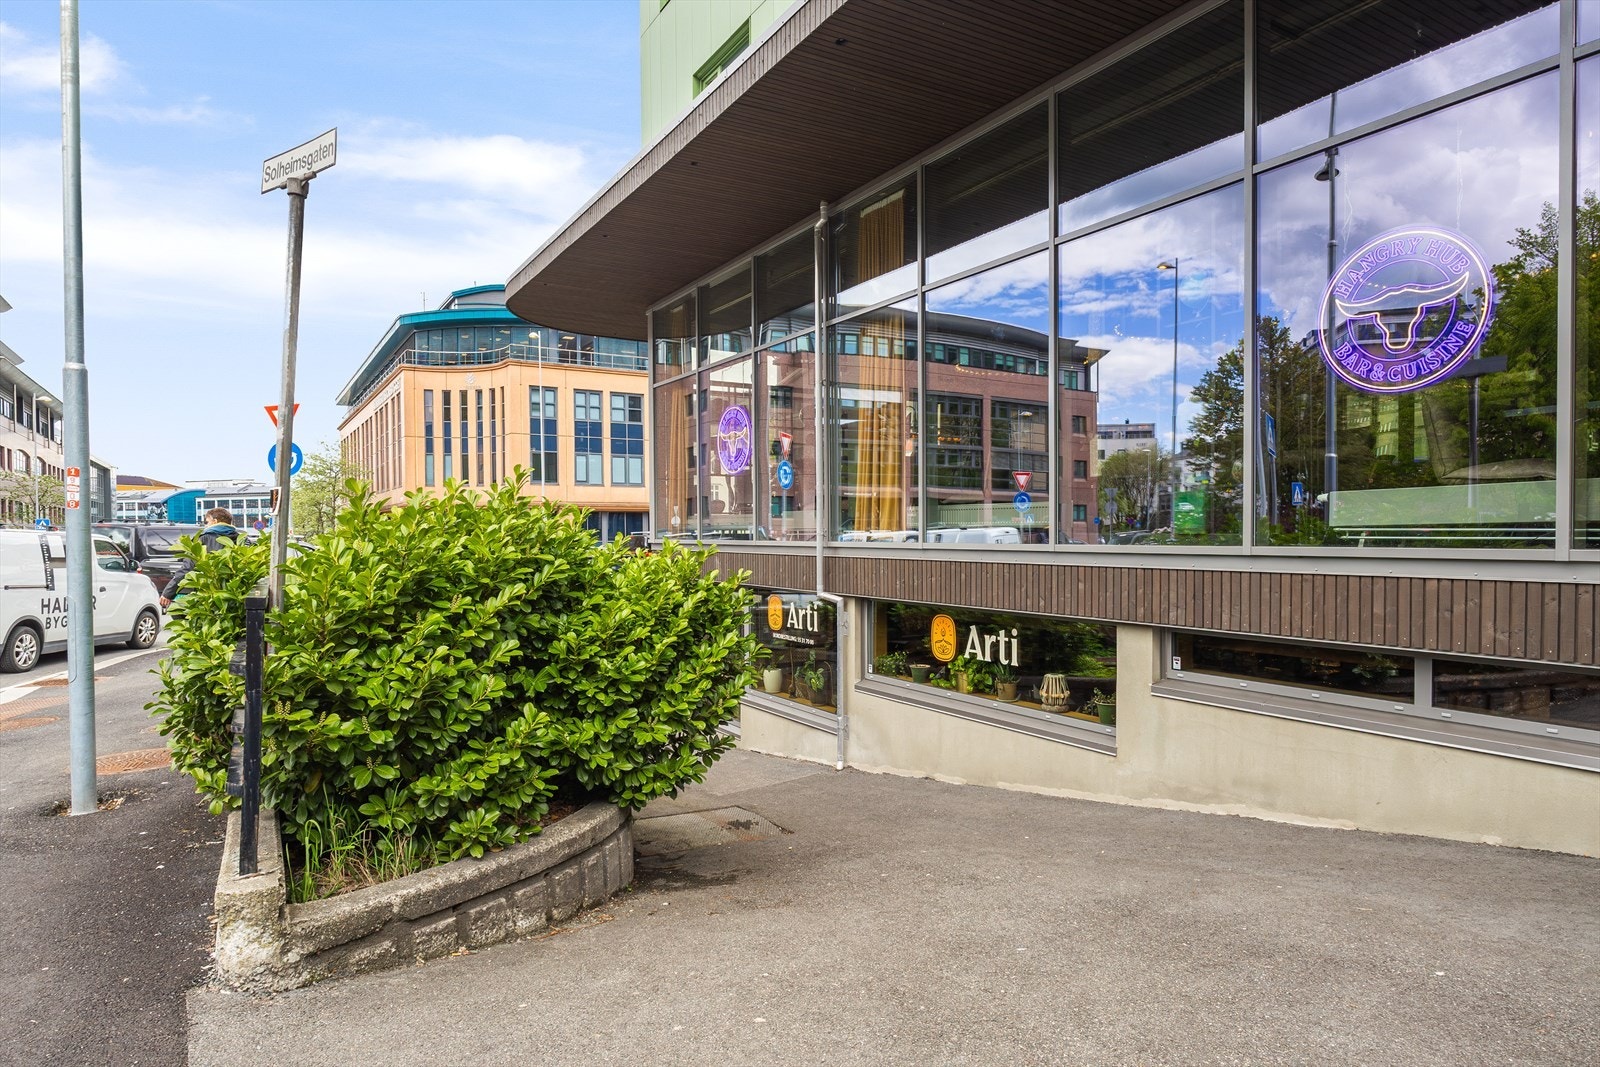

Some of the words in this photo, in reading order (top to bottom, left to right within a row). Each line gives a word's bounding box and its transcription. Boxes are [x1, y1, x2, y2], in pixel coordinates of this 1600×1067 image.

[264, 142, 334, 183] Solheimsgaten
[1333, 237, 1423, 299] HANGRY
[1424, 238, 1471, 274] HUB
[45, 615, 68, 629] BYG
[787, 601, 818, 632] Arti
[964, 625, 1019, 667] Arti
